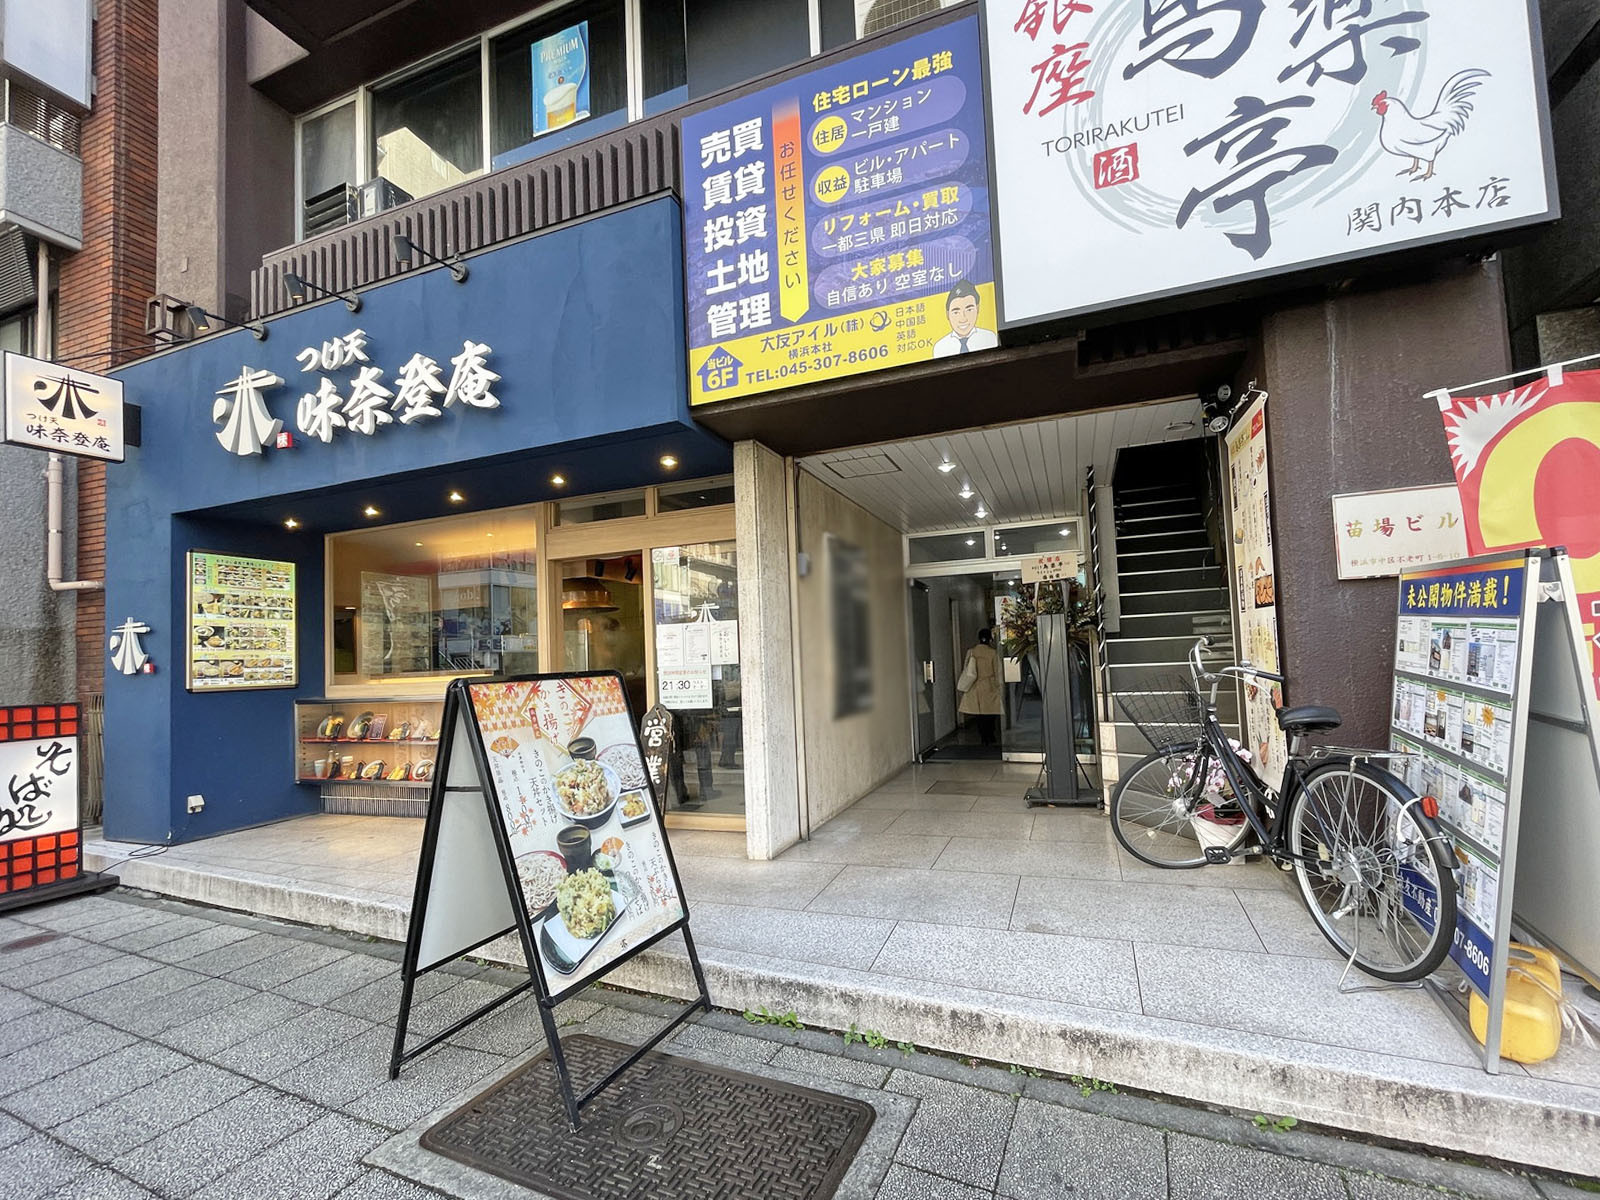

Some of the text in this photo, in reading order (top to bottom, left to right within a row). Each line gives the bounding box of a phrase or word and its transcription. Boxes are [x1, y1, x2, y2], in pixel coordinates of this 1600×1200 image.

[813, 51, 953, 112] 住宅ローン最強
[851, 89, 931, 122] マンション
[700, 117, 764, 168] 売買
[815, 125, 844, 146] 住居
[852, 116, 900, 139] 一戸建
[1041, 104, 1184, 157] TORIRAKUTEI
[855, 133, 960, 175] ビル・アパート
[1097, 147, 1136, 186] 酒
[702, 161, 765, 211] 賃貸
[818, 175, 847, 196] 収益
[854, 167, 902, 194] 駐車場
[1176, 96, 1338, 260] 亭
[779, 142, 801, 289] お任せください
[824, 186, 960, 235] リフォーム・買取
[1347, 177, 1512, 236] 関内本店
[703, 204, 767, 253] 投資
[822, 208, 958, 252] 一都三県 即日対応
[706, 249, 770, 295] 土地
[828, 262, 962, 306] 自信あり 空室なし
[852, 248, 924, 281] 大家募集
[707, 292, 772, 338] 管理
[895, 303, 925, 318] 日本語
[895, 315, 926, 329] 中国語
[296, 329, 371, 372] つけ天
[788, 342, 832, 360] 横浜本社
[896, 329, 916, 341] 英語
[897, 338, 933, 353] 対応OK
[707, 355, 733, 370] 当ビル
[707, 368, 734, 389] 6F
[746, 345, 888, 384] TEL:045-307-8606
[297, 340, 502, 443] 味奈登庵
[26, 412, 60, 425] つけ天
[26, 424, 110, 452] 味奈登庵
[1345, 512, 1459, 538] 苗場ビル
